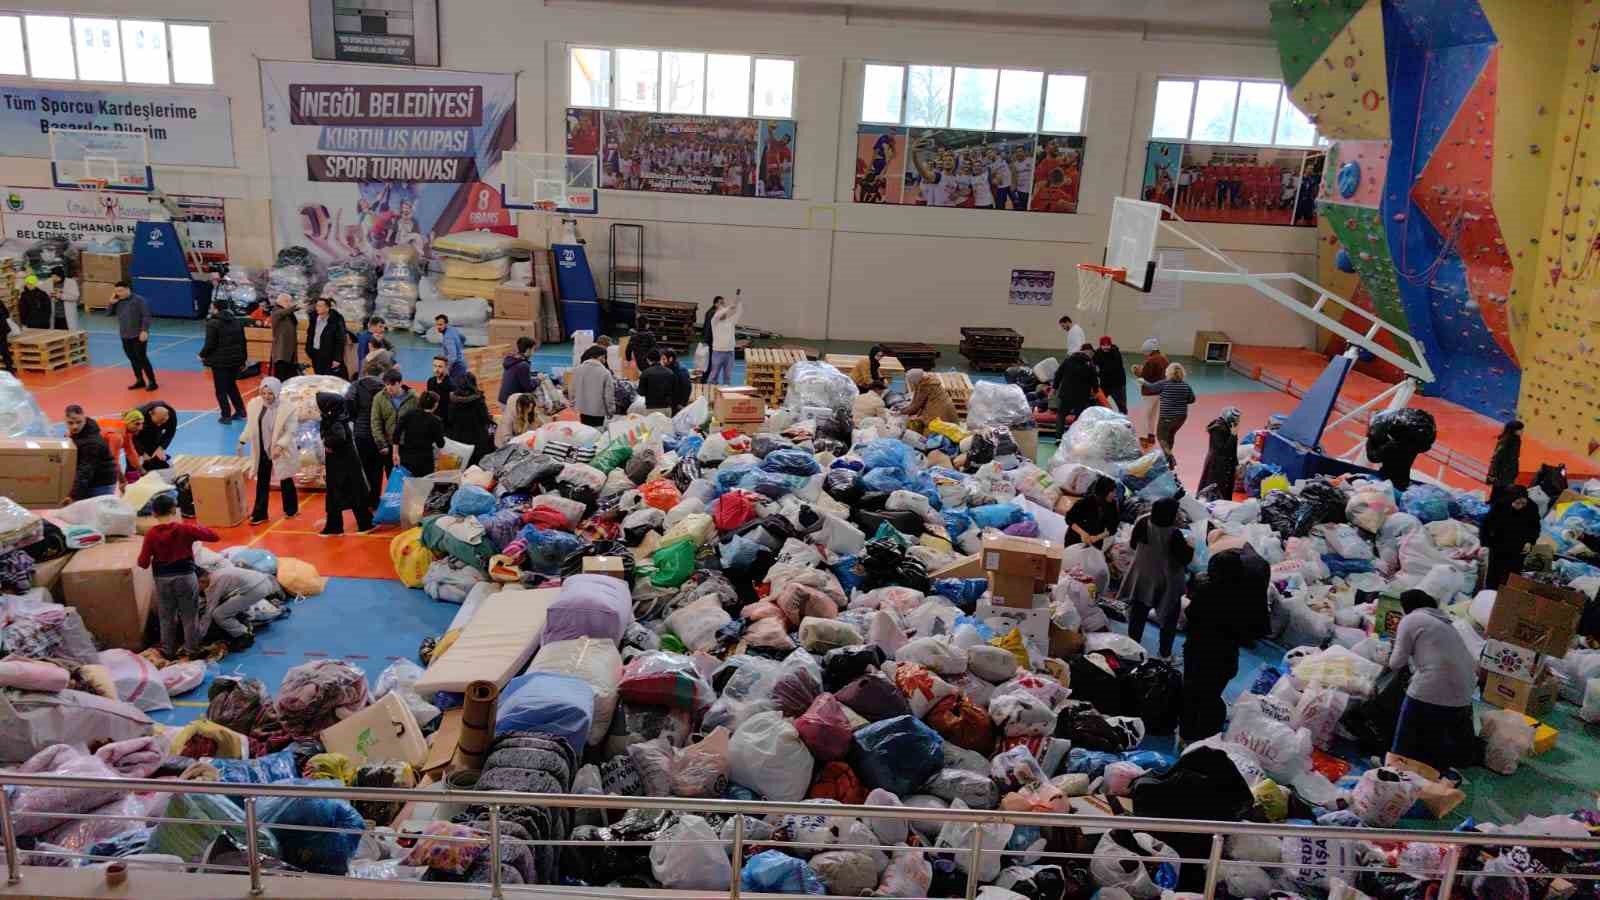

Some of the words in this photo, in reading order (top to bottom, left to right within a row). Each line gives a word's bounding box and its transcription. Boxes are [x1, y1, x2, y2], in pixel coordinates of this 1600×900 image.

[4, 94, 36, 111] Tüm
[42, 97, 93, 115] Sporcu
[99, 99, 197, 121] Kardeşlerime
[300, 86, 364, 118] İNEGÖL
[369, 87, 474, 118] BELEDİYESİ
[411, 129, 468, 152] KUPASI
[325, 156, 367, 178] SPOR
[371, 158, 458, 180] TURNUVASI
[479, 190, 489, 209] 8
